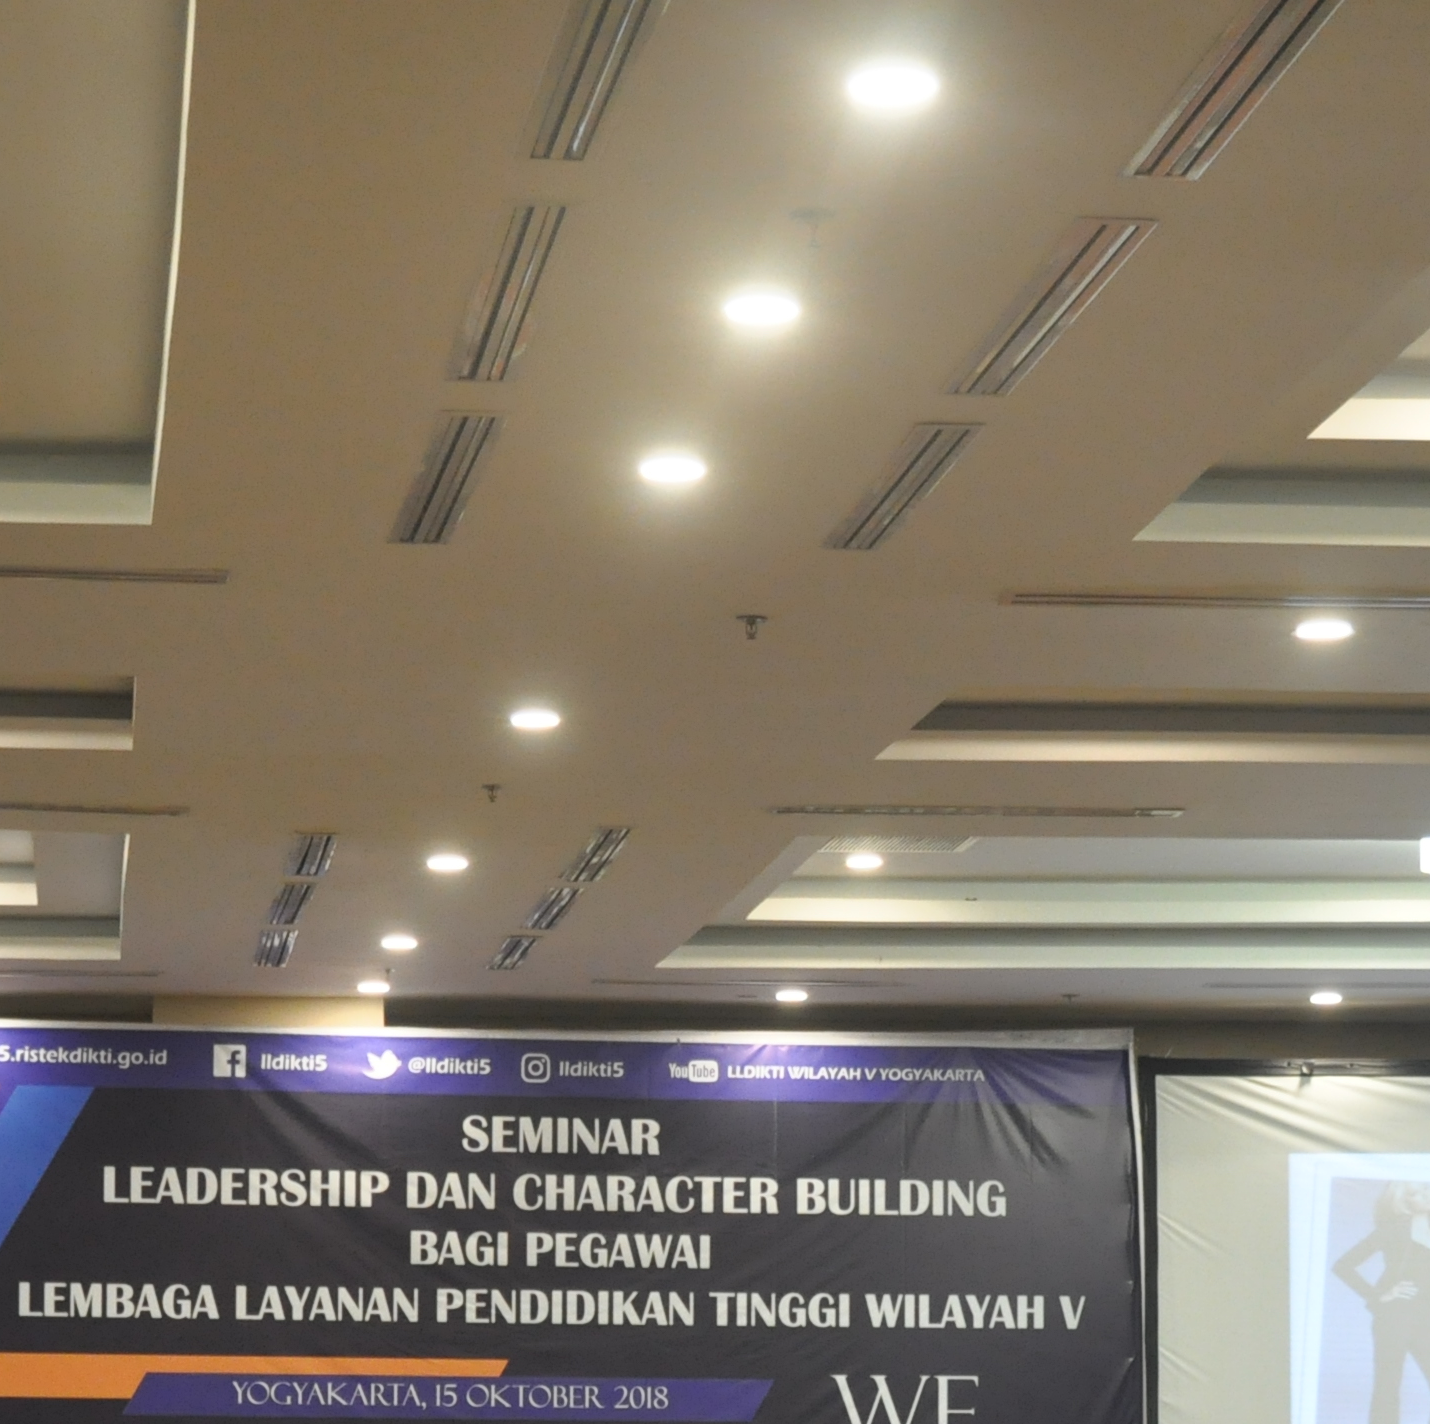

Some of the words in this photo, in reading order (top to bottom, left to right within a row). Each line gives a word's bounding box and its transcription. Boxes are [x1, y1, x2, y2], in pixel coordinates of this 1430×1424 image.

[260, 1053, 328, 1072] lldikti5
[407, 1055, 491, 1075] @lldikti5
[559, 1061, 625, 1078] lldikti5
[727, 1064, 785, 1080] LLDIKTI
[786, 1064, 861, 1080] WILAYAH
[864, 1067, 877, 1081] V
[879, 1067, 985, 1083] YOGYAKARTA
[461, 1114, 661, 1156] SEMINAR
[103, 1165, 390, 1208] LEADERSHIP
[406, 1171, 496, 1210] DAN
[513, 1173, 779, 1215] CHARACTER
[796, 1177, 1007, 1217] BUILDING
[410, 1229, 509, 1267] BAGI
[526, 1231, 711, 1270] PEGAWAI
[18, 1281, 220, 1320] LEMBAGA
[235, 1284, 419, 1323] LAYANAN
[436, 1288, 695, 1327] PENDIDIKAN
[708, 1291, 851, 1328] TINGGI
[864, 1293, 1045, 1330] WILAYAH
[1058, 1295, 1086, 1330] V
[232, 1380, 427, 1410] YOGYAKARTA,
[435, 1383, 458, 1408] 15
[465, 1383, 604, 1409] OKTOBER
[614, 1385, 669, 1409] 2018
